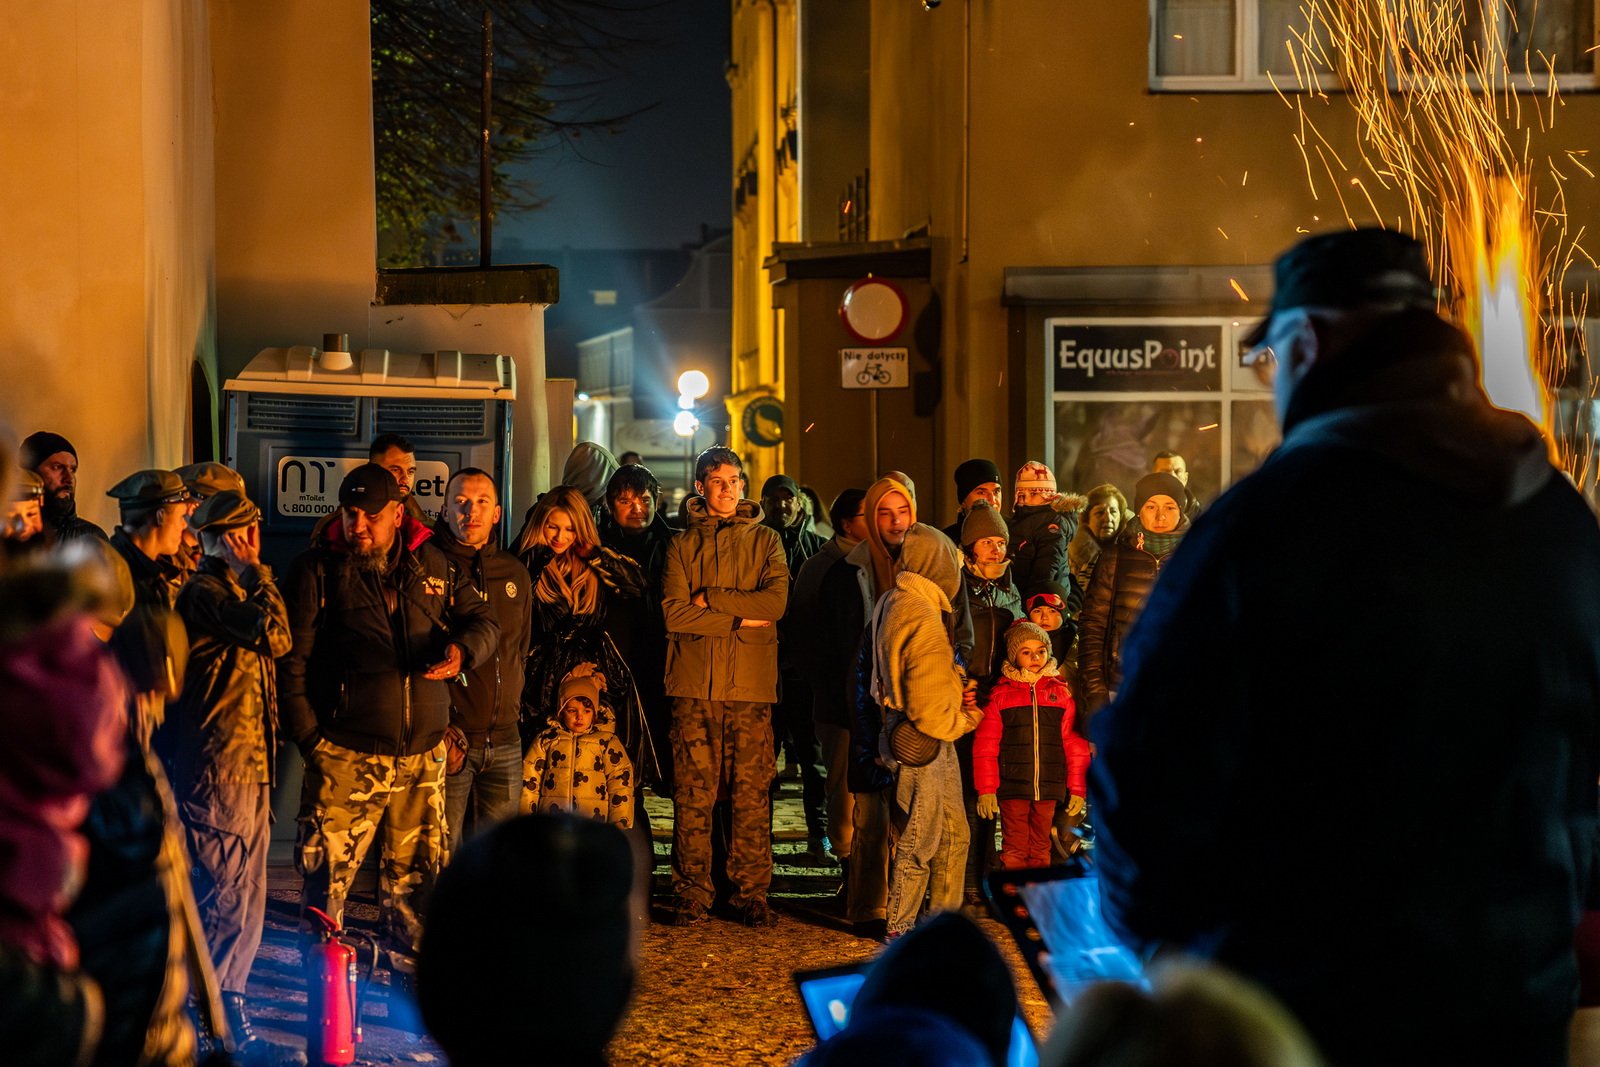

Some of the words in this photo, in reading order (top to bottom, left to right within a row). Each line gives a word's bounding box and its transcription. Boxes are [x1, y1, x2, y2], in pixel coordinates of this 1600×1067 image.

[844, 351, 861, 360] Nie
[867, 351, 905, 362] dotyczy
[411, 475, 445, 497] et
[291, 503, 312, 514] 800
[314, 504, 335, 514] 000
